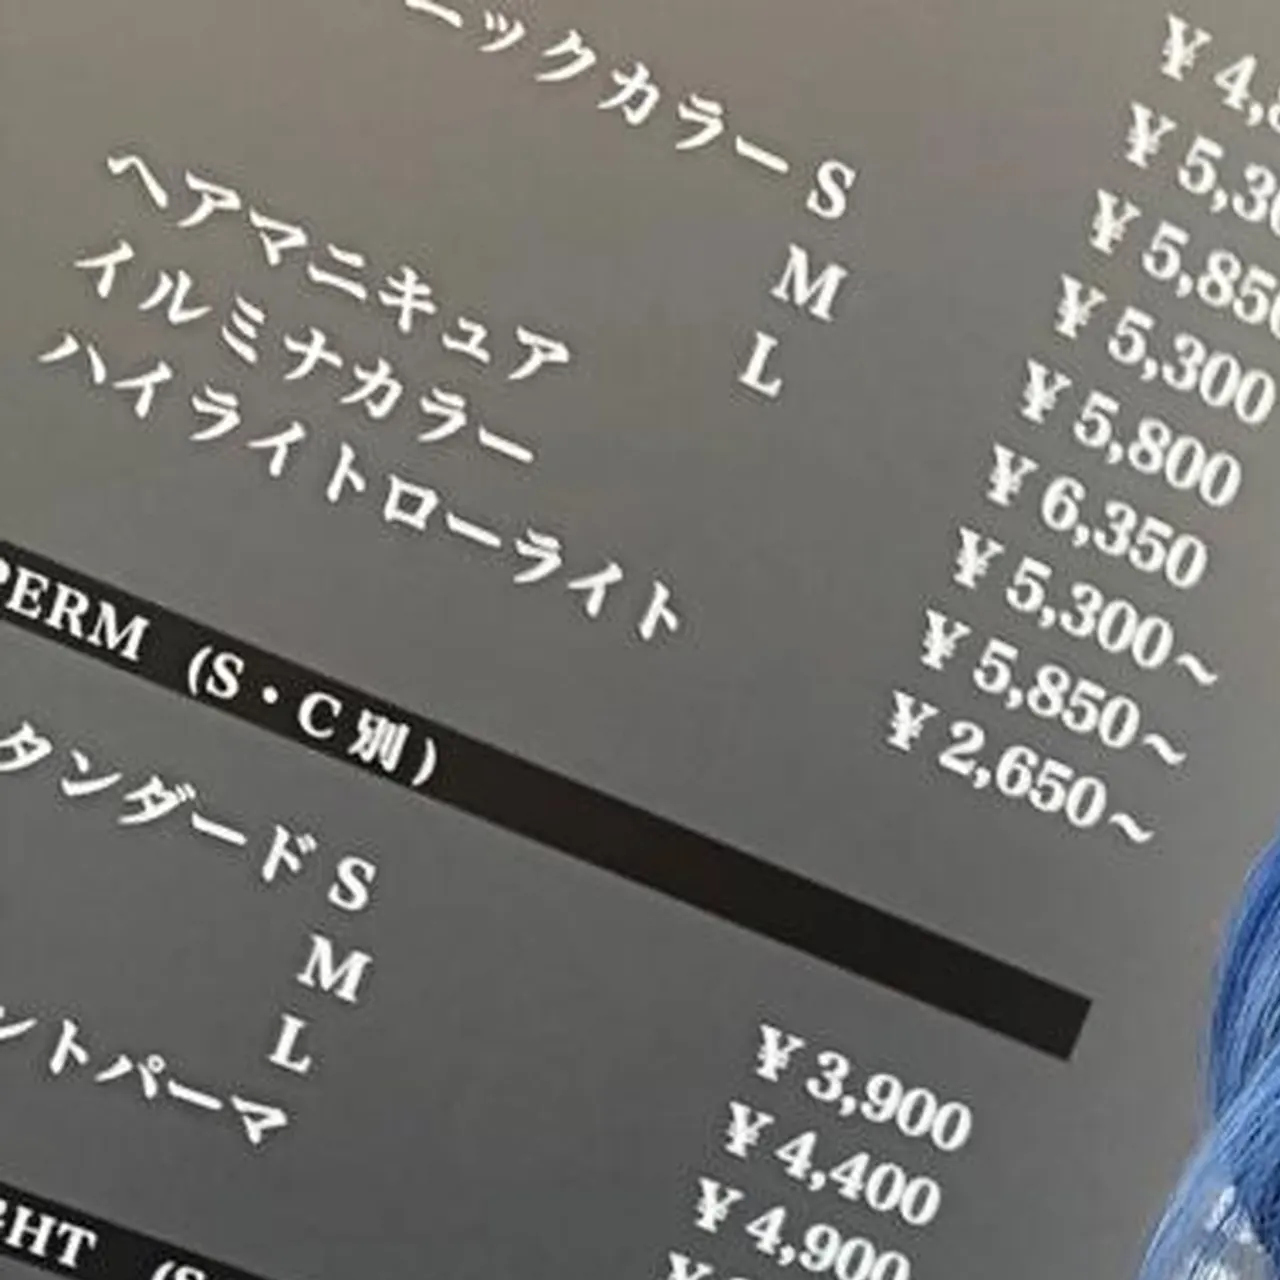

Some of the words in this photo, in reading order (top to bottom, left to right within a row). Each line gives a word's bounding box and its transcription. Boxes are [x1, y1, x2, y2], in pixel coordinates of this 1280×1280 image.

[806, 160, 856, 219] S
[107, 155, 570, 380] ヘアマニキュア
[771, 243, 848, 321] M
[74, 241, 534, 463] イルミナカラー
[739, 331, 782, 397] L
[1055, 273, 1276, 425] ¥5,300
[39, 334, 679, 640] ハイライトローライト
[1021, 359, 1241, 507] ¥5,800
[987, 443, 1207, 589] ¥6,350
[0, 721, 318, 882] タンダード
[327, 856, 376, 911] S
[296, 934, 373, 1003] M
[268, 1014, 312, 1074] L
[755, 1024, 972, 1151] ¥3,900
[725, 1101, 941, 1226] ¥4,400
[0, 1199, 97, 1267] HT
